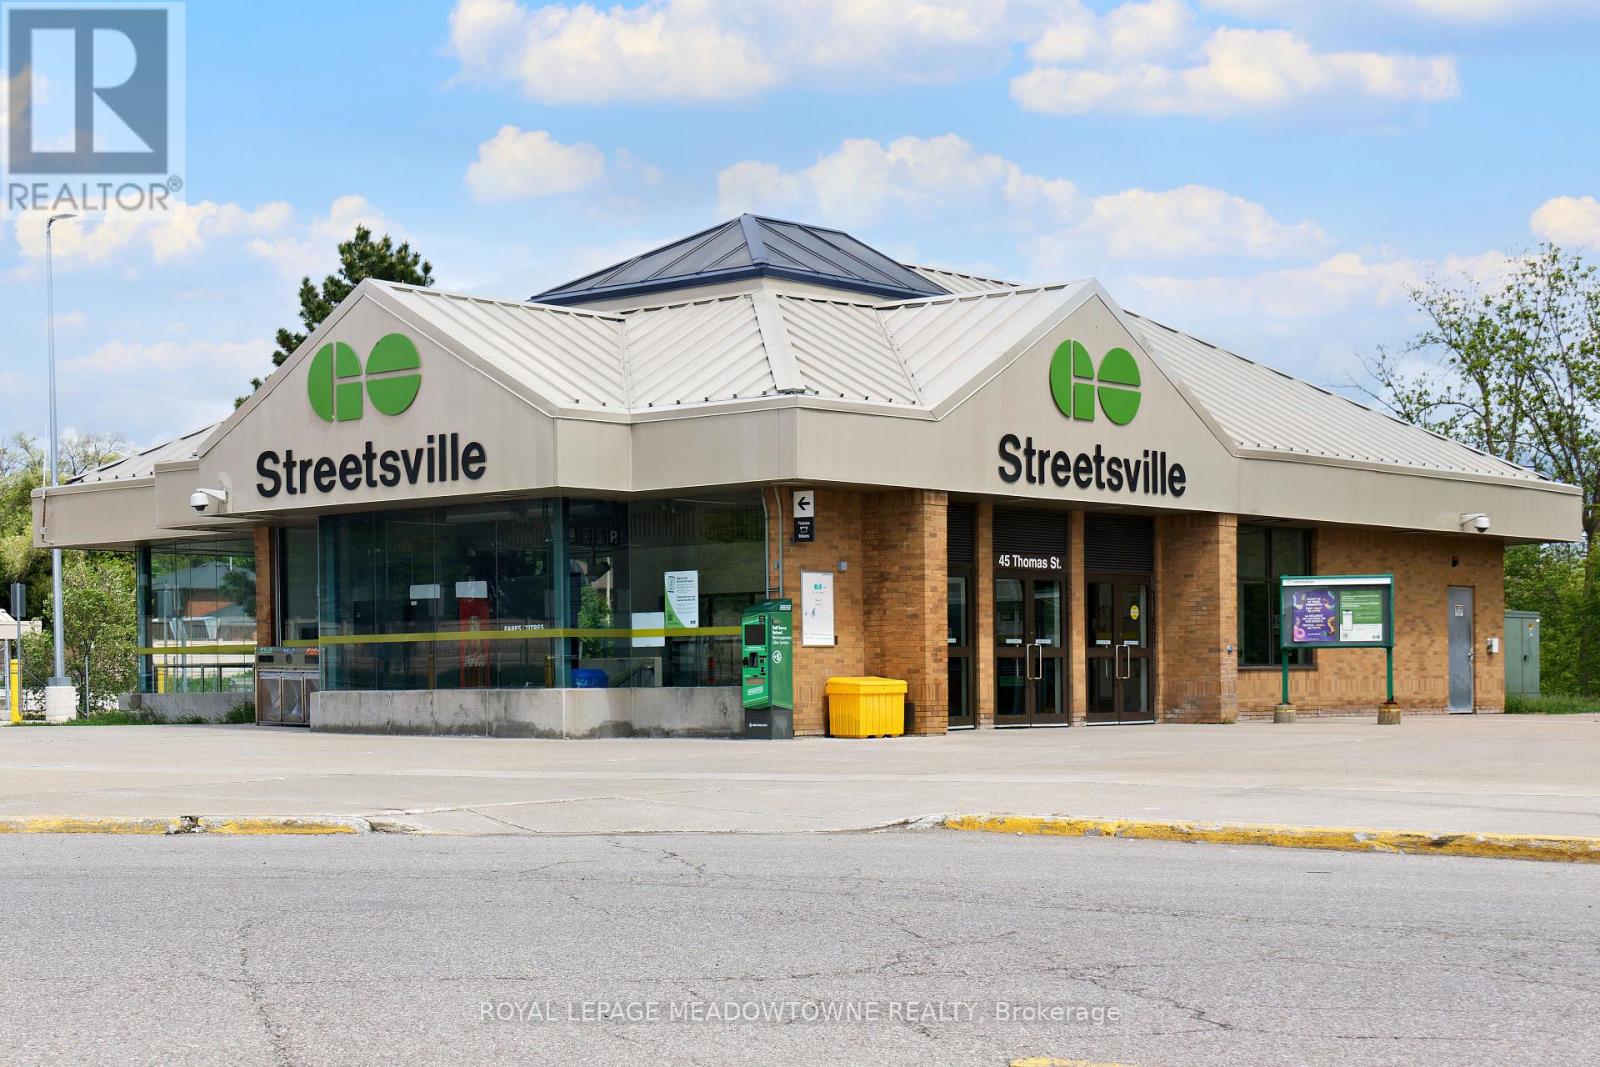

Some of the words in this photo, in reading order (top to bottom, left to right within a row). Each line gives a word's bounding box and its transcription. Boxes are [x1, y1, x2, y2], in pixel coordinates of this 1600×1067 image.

[256, 432, 487, 498] Streetsville
[997, 433, 1187, 498] Streetsville
[998, 554, 1011, 567] 45
[1012, 554, 1048, 569] Thomas
[1050, 556, 1062, 569] St.
